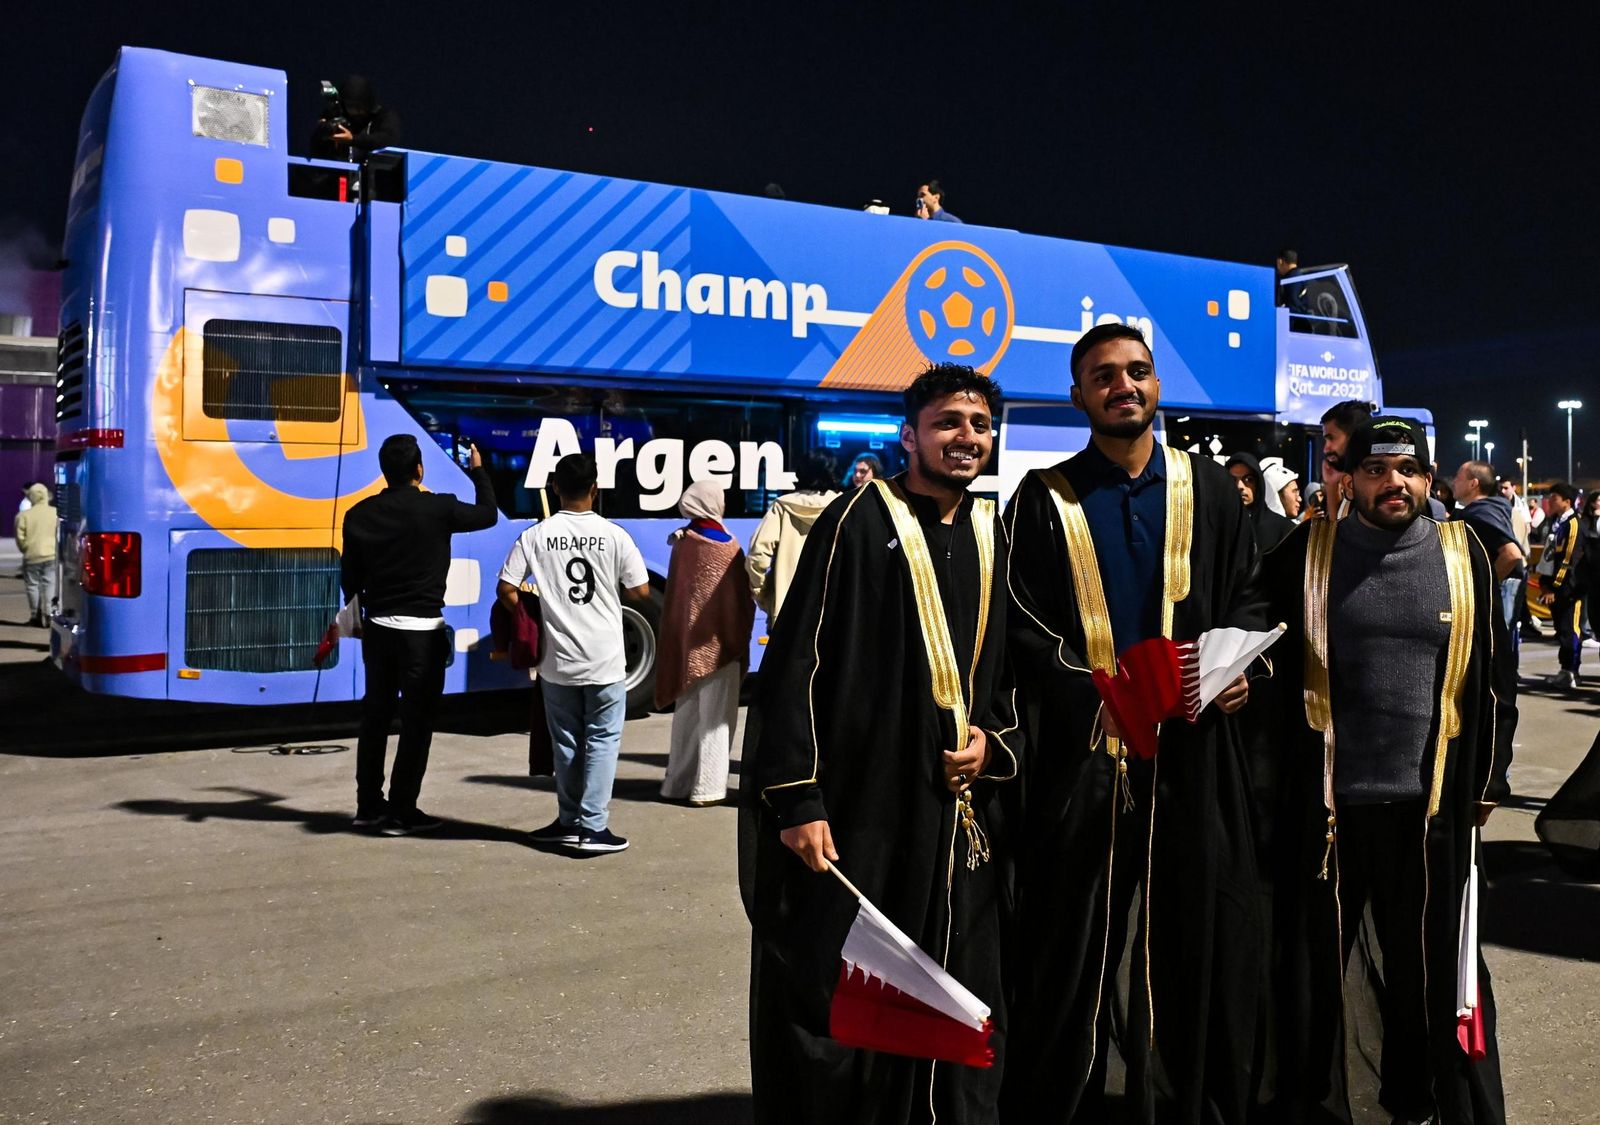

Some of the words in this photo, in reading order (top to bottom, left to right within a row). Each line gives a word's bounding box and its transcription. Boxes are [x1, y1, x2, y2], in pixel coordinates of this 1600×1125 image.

[593, 249, 828, 338] Champ
[1309, 365, 1348, 381] WORLD
[1348, 368, 1370, 382] CUP
[523, 417, 786, 511] Argen
[546, 536, 606, 552] MBAPPE
[565, 556, 595, 606] 9
